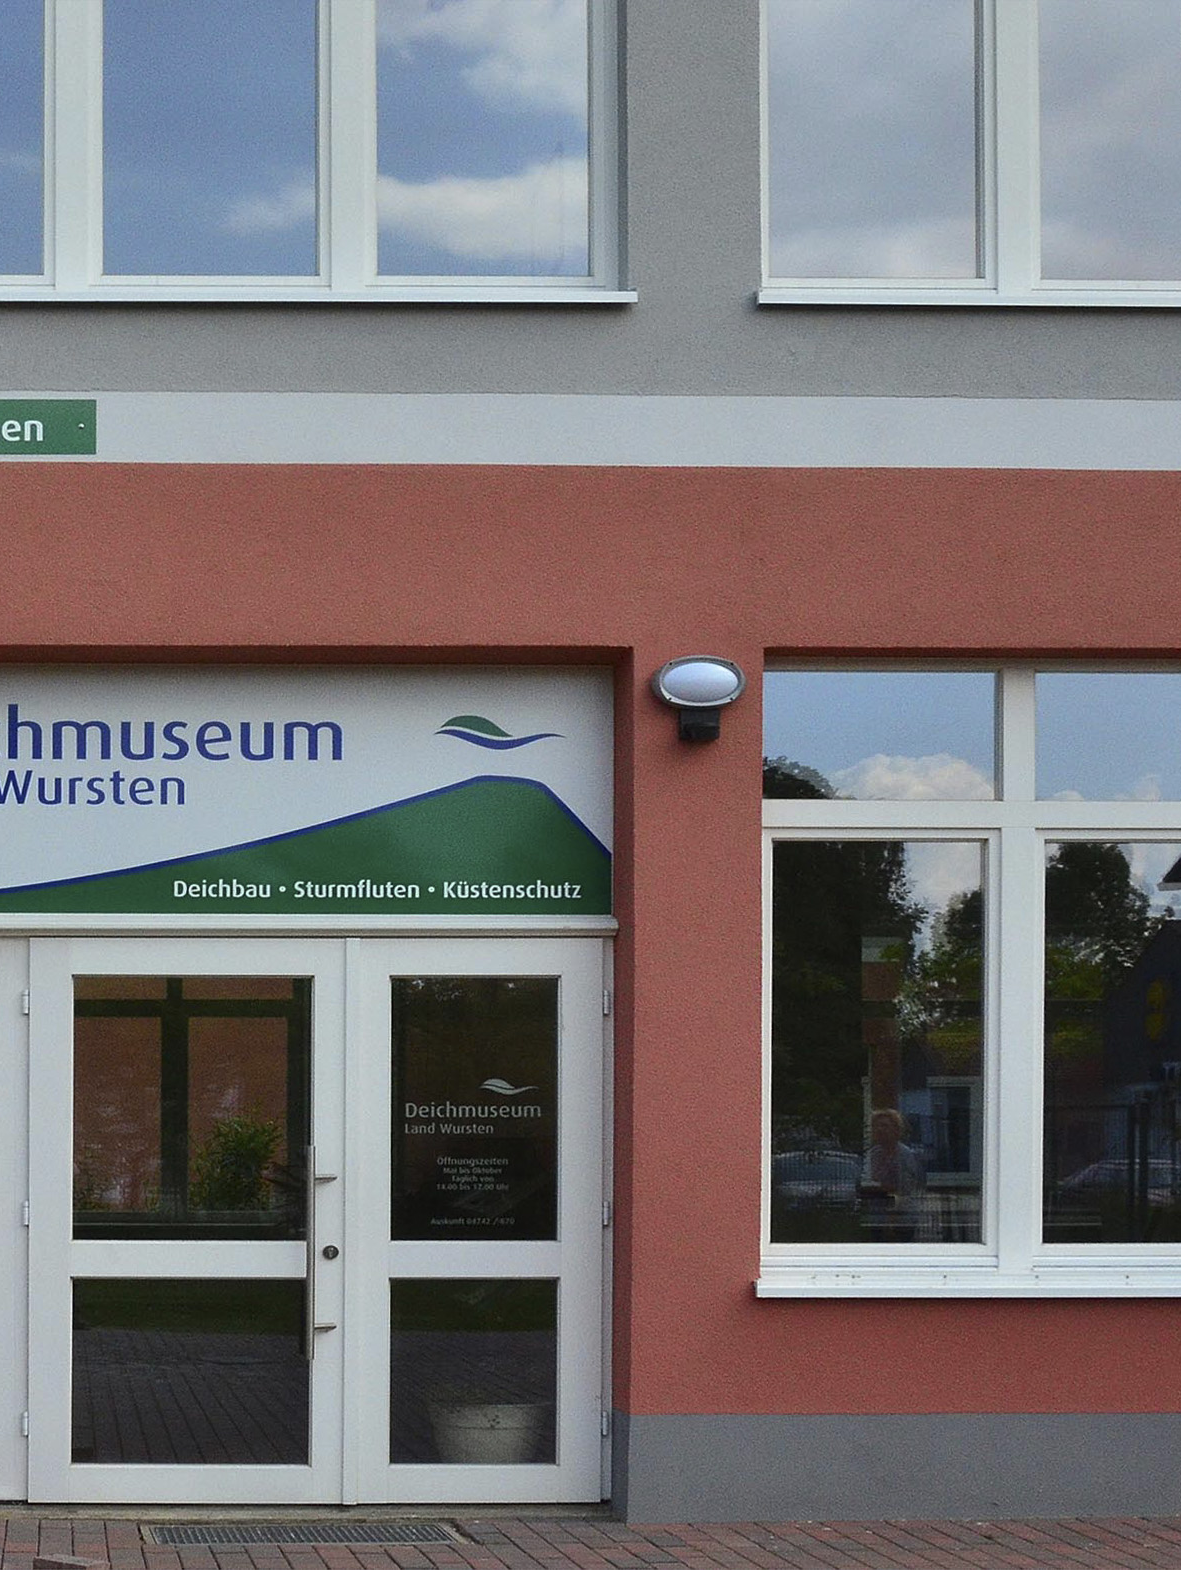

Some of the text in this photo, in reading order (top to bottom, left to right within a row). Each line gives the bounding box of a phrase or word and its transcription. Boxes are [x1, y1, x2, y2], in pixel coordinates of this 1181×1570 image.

[173, 878, 582, 899] Deichbau Sturmfluten Küstenschutz
[405, 1100, 542, 1118] Deichmuseum
[404, 1122, 494, 1135] Land Wursten
